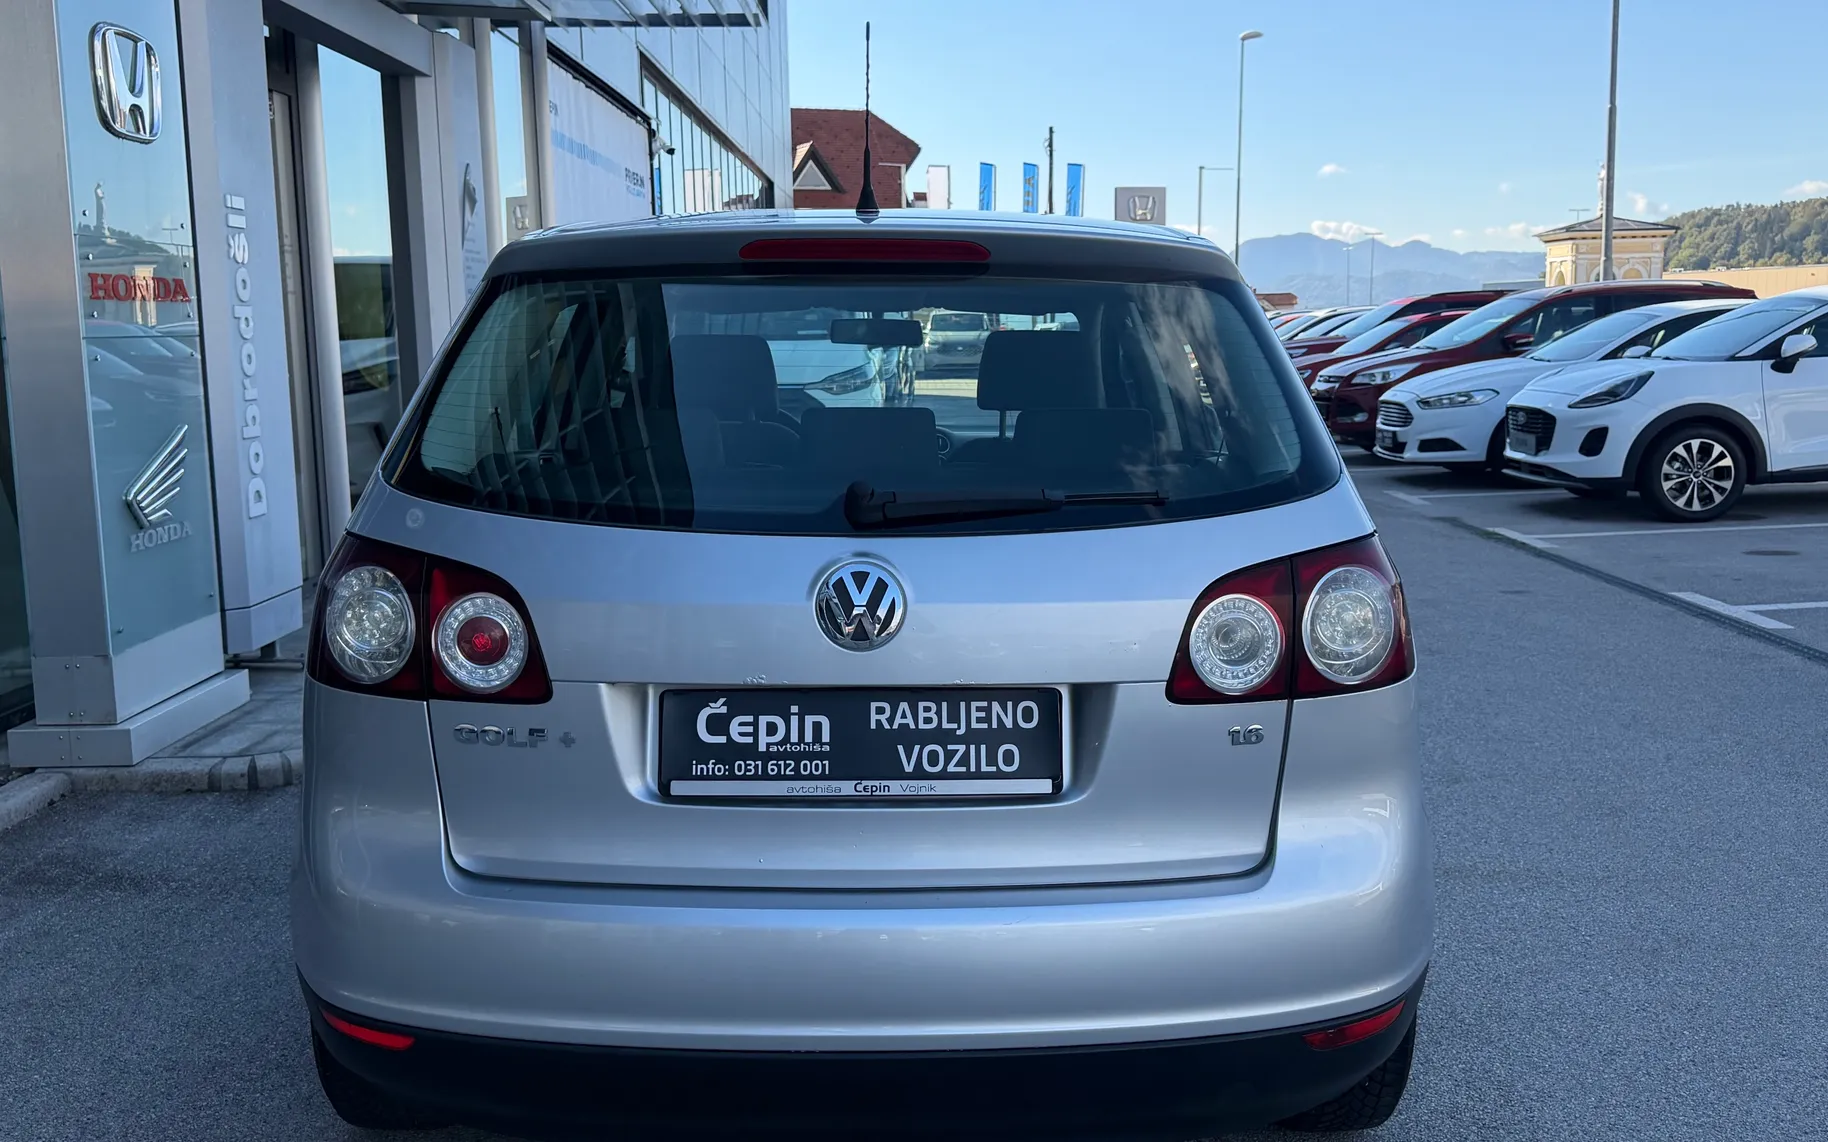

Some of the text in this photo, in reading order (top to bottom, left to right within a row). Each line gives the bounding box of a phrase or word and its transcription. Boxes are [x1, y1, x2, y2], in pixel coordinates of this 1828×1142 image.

[88, 273, 191, 303] HONDA
[225, 194, 267, 519] Dobrodošli
[130, 521, 192, 552] HONDA
[696, 697, 830, 752] Čepin
[870, 700, 1039, 735] RABLJENO
[453, 723, 548, 748] GOLF
[768, 743, 830, 752] avtohiša
[692, 759, 829, 776] info: 031 612 001
[897, 744, 1020, 773] VOZILO
[786, 784, 842, 794] avtohiša
[900, 783, 937, 794] Vojnik
